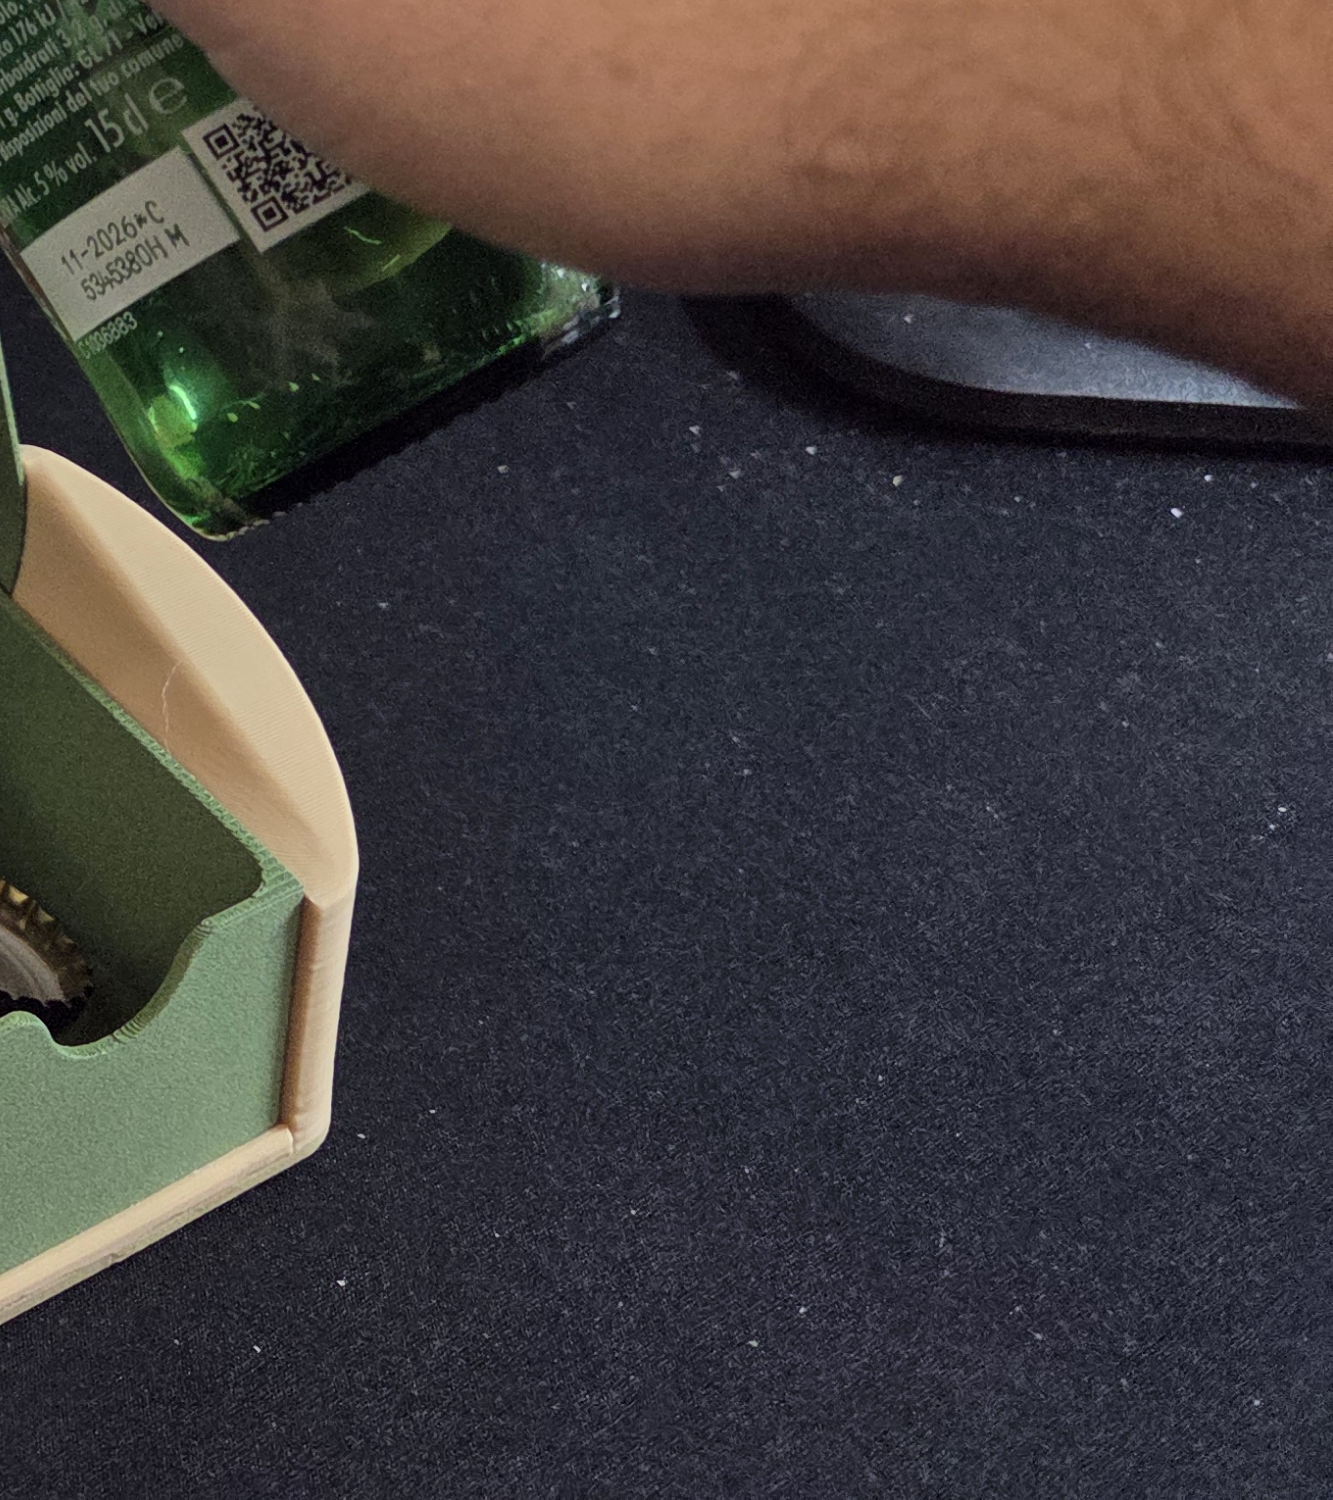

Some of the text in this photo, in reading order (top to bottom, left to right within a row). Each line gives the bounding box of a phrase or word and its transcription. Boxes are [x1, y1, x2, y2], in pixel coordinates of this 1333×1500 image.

[7, 15, 39, 46] 176
[31, 2, 58, 30] kJ
[11, 56, 84, 118] Bottiglia:
[60, 80, 95, 115] del
[86, 65, 121, 98] tuo
[119, 28, 186, 83] comune
[82, 106, 129, 156] 15
[111, 90, 151, 138] cl
[41, 157, 71, 189] %
[59, 137, 99, 176] vol.
[31, 170, 53, 197] 5
[161, 220, 191, 253] M
